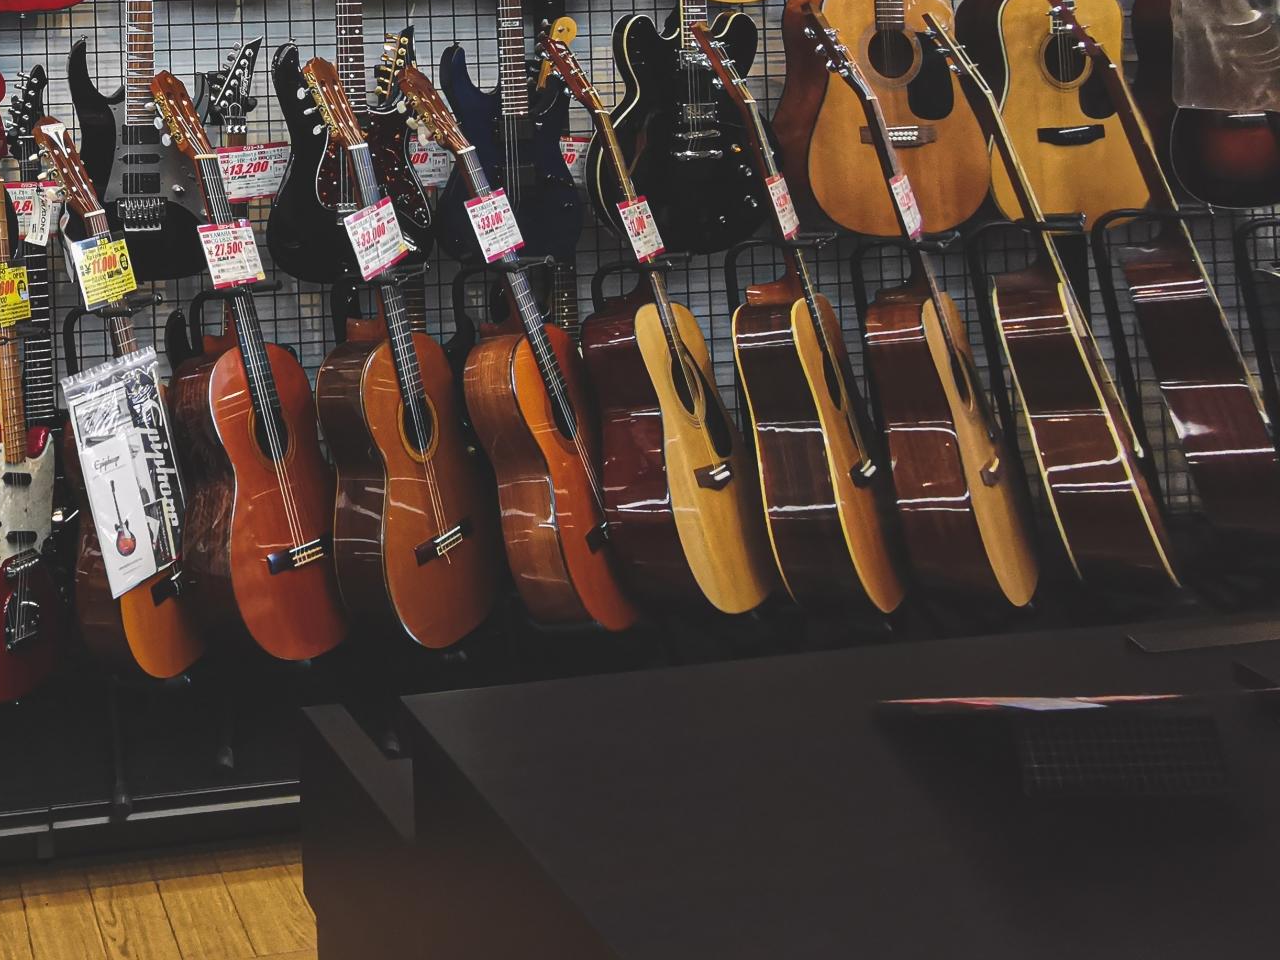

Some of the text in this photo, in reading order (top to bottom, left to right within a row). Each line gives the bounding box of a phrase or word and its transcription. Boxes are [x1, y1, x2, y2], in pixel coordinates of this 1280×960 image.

[223, 160, 269, 176] ¥13,200
[208, 241, 243, 257] ¥27,500
[143, 397, 180, 528] Epiphone
